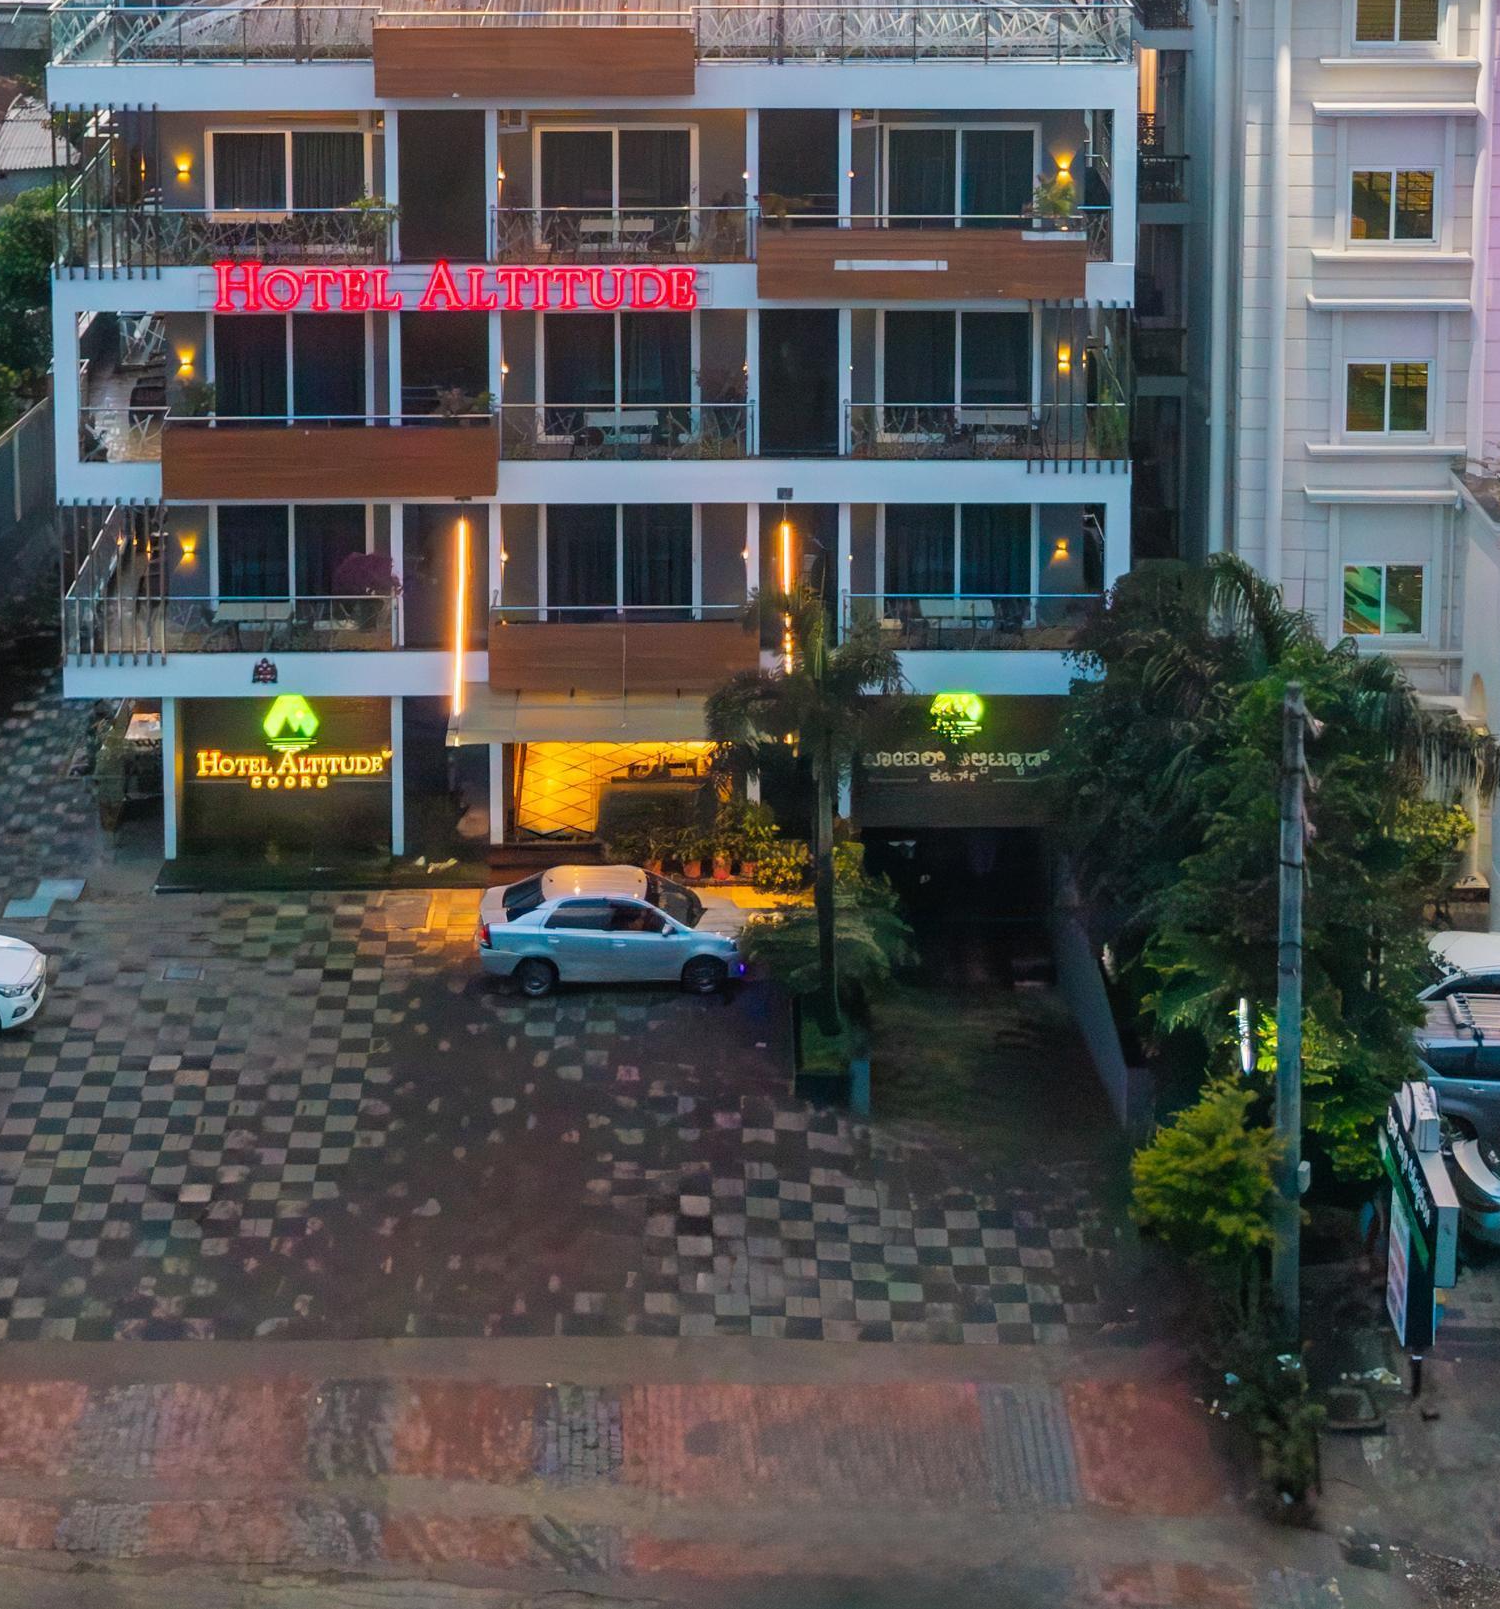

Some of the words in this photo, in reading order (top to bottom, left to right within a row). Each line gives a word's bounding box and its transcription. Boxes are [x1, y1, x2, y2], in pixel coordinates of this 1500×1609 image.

[213, 260, 402, 313] HOTEL
[419, 260, 698, 311] ALTITUDE
[196, 750, 273, 777] HOTEL
[276, 750, 383, 776] ALTITUDE
[250, 775, 329, 789] COORG
